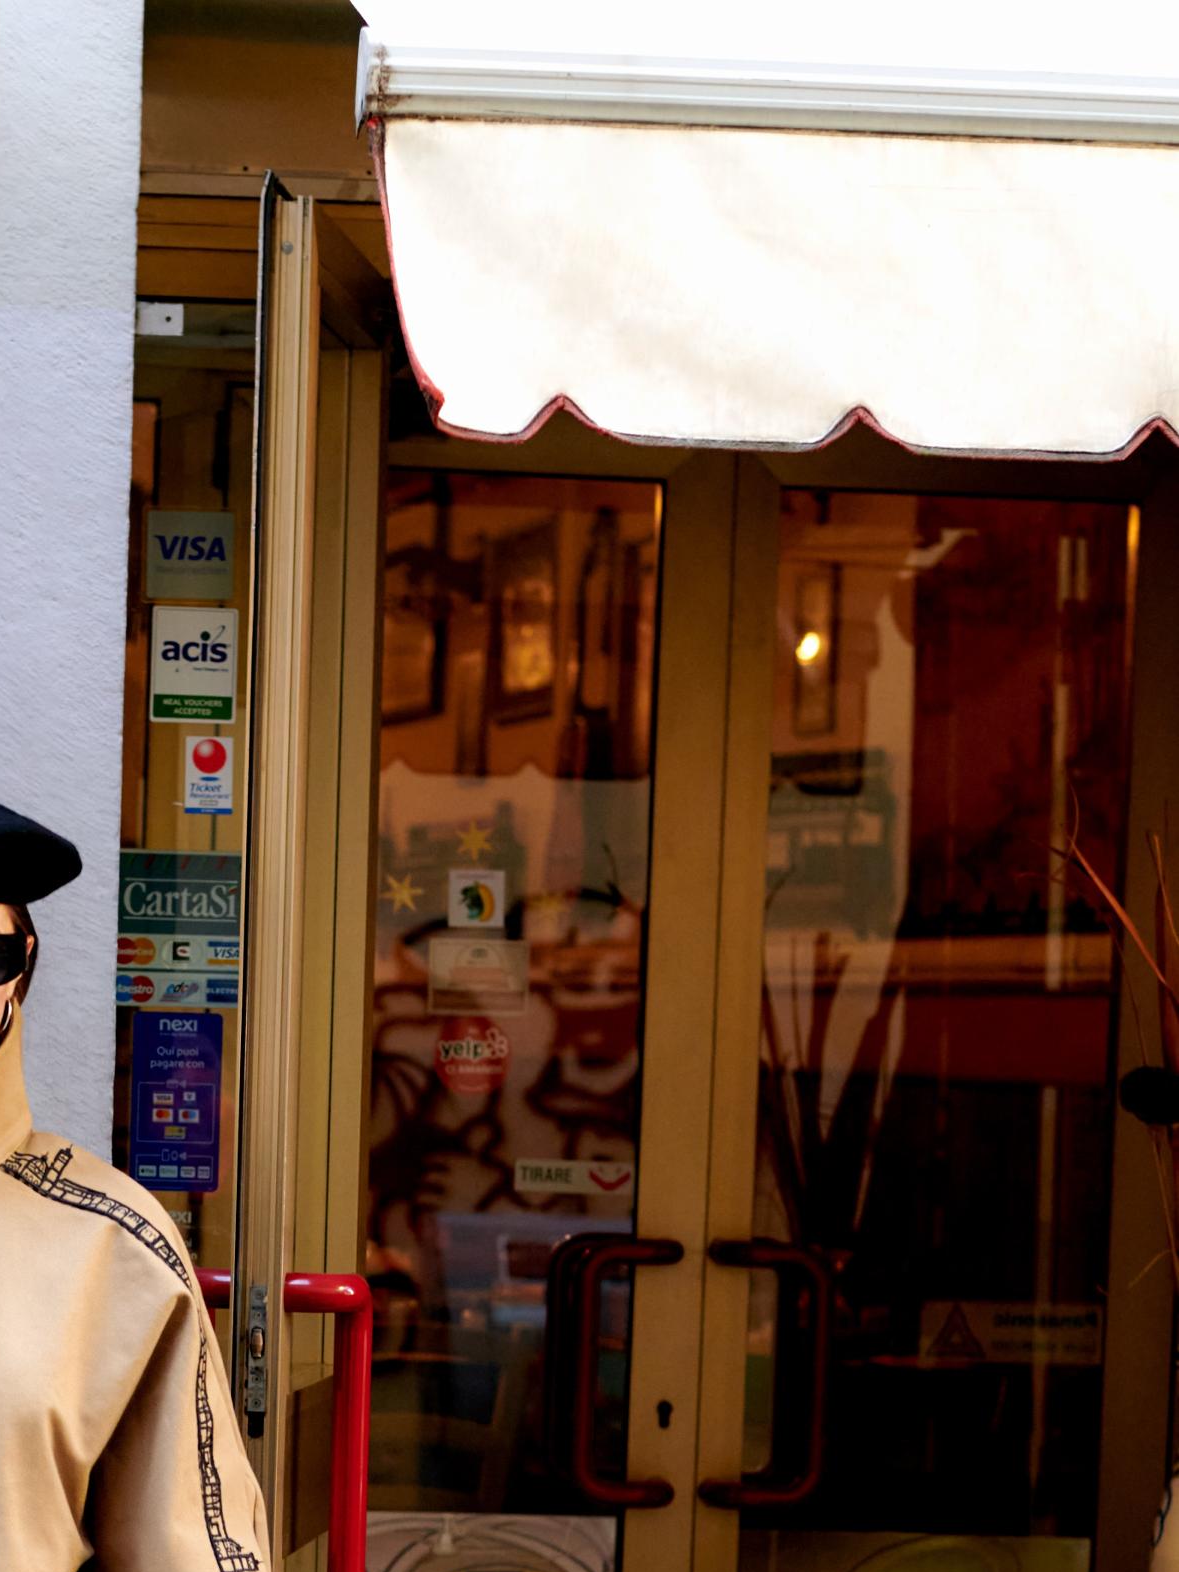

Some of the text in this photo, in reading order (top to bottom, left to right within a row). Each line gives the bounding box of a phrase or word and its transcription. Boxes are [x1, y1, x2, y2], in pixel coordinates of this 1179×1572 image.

[154, 535, 226, 561] VISA
[161, 631, 228, 663] acis
[162, 698, 223, 708] MEAL VOUCHERS
[173, 707, 213, 716] ACCEPTED
[190, 783, 222, 792] Ticket
[159, 1018, 198, 1031] nexi
[157, 1046, 199, 1058] Qui puoi
[440, 1038, 483, 1060] yelp
[150, 1060, 205, 1070] pagare con
[520, 1165, 572, 1184] TIRARE
